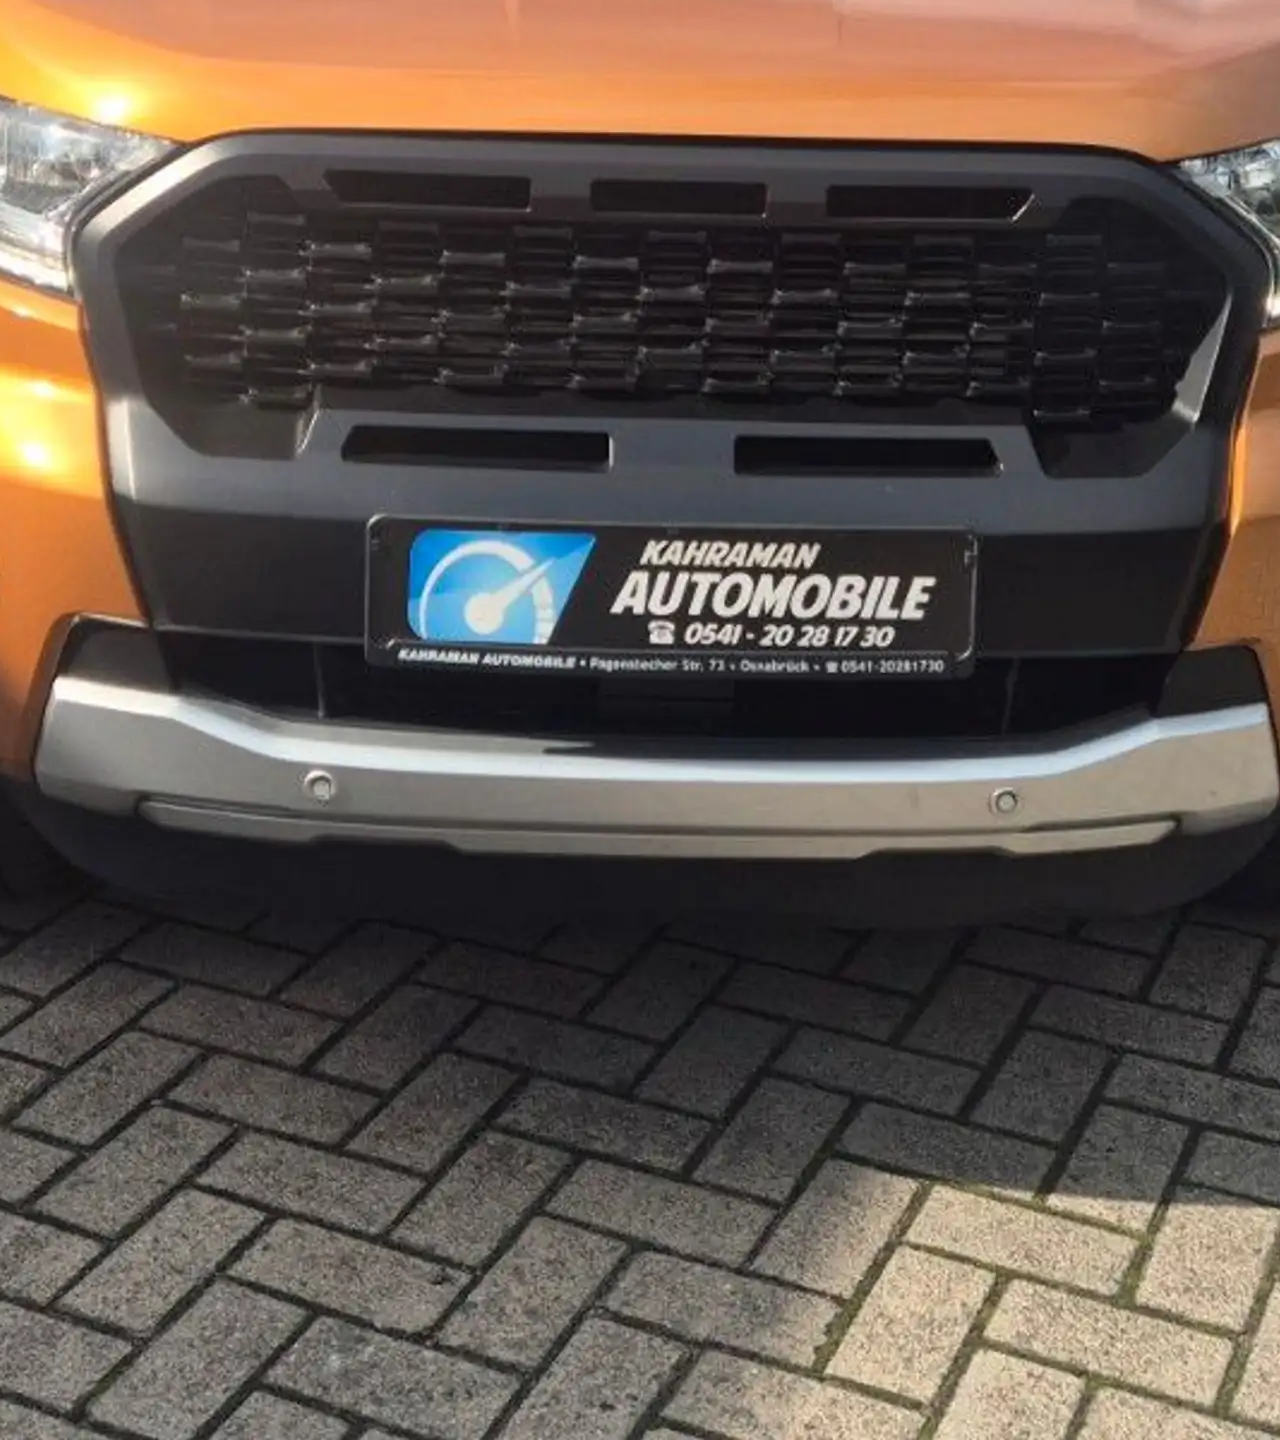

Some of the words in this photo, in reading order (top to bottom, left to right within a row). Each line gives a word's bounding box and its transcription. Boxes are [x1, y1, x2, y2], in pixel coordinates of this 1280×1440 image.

[639, 539, 821, 569] KAHRAMAN
[610, 571, 937, 621] AUTOMOBILE
[683, 622, 743, 645] 0541
[759, 625, 794, 647] 20
[796, 625, 831, 647] 28
[833, 626, 859, 647] 17
[859, 626, 896, 648] 30
[397, 648, 480, 665] KAHRAMAN
[480, 652, 577, 670] AUTOMOBILE
